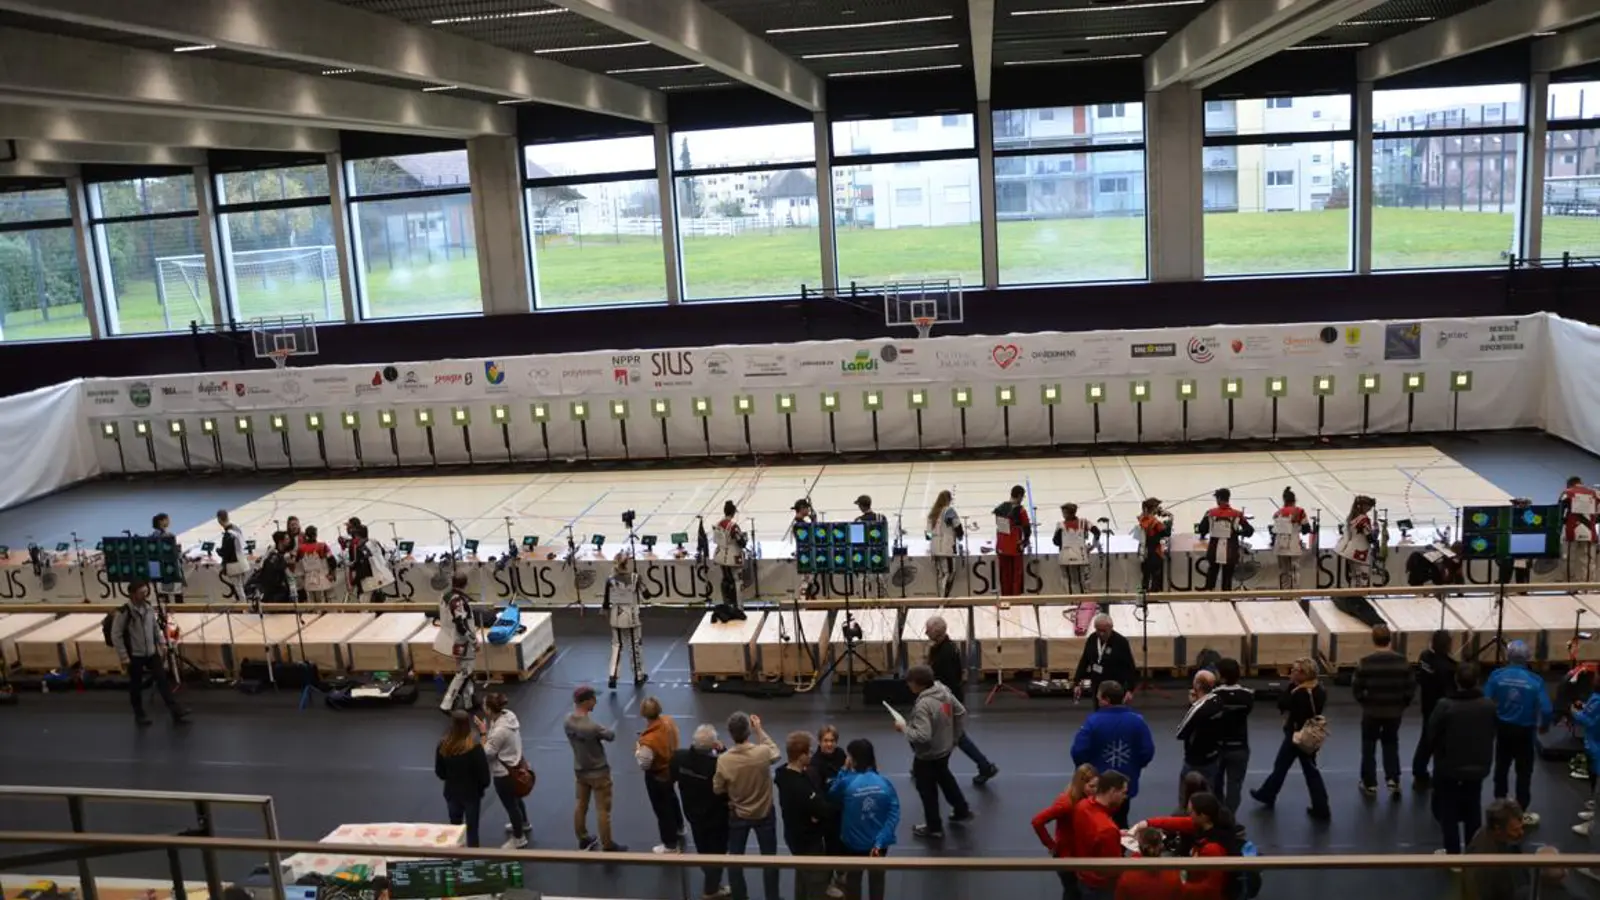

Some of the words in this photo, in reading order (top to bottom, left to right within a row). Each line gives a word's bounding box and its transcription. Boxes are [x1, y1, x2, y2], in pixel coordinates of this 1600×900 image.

[612, 355, 641, 365] NPPR
[651, 351, 693, 376] SIUS
[841, 358, 878, 372] Landi
[493, 566, 556, 598] SIUS
[646, 565, 713, 598] SIUS
[972, 560, 1043, 594] SIS
